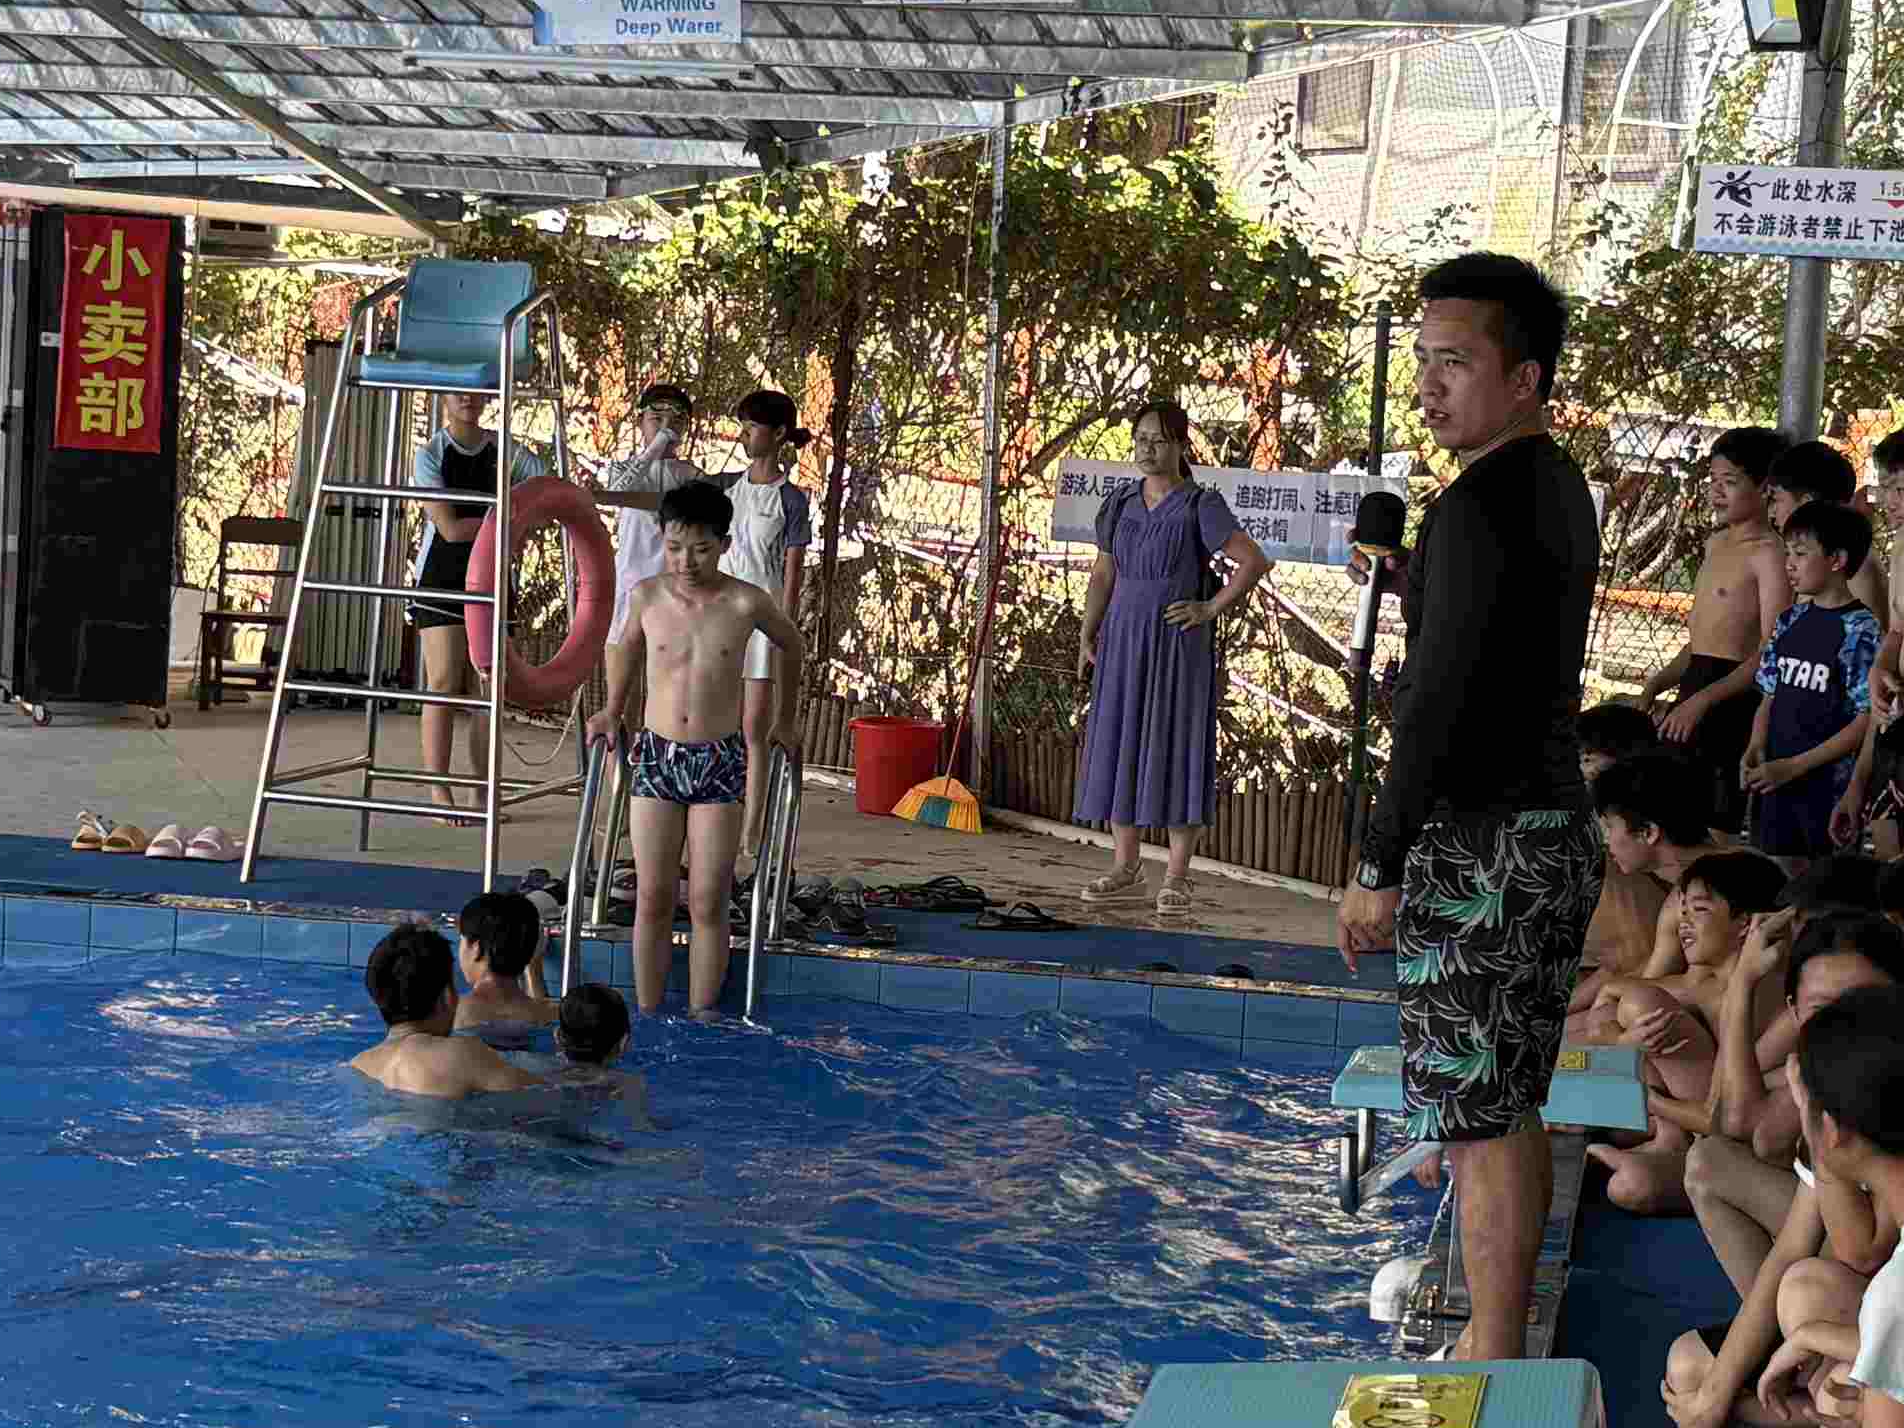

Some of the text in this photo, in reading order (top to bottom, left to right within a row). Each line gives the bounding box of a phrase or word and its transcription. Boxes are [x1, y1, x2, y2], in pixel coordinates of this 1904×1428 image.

[616, 19, 661, 38] Deep
[1771, 178, 1857, 204] 此处水深
[76, 229, 150, 436] 小卖部
